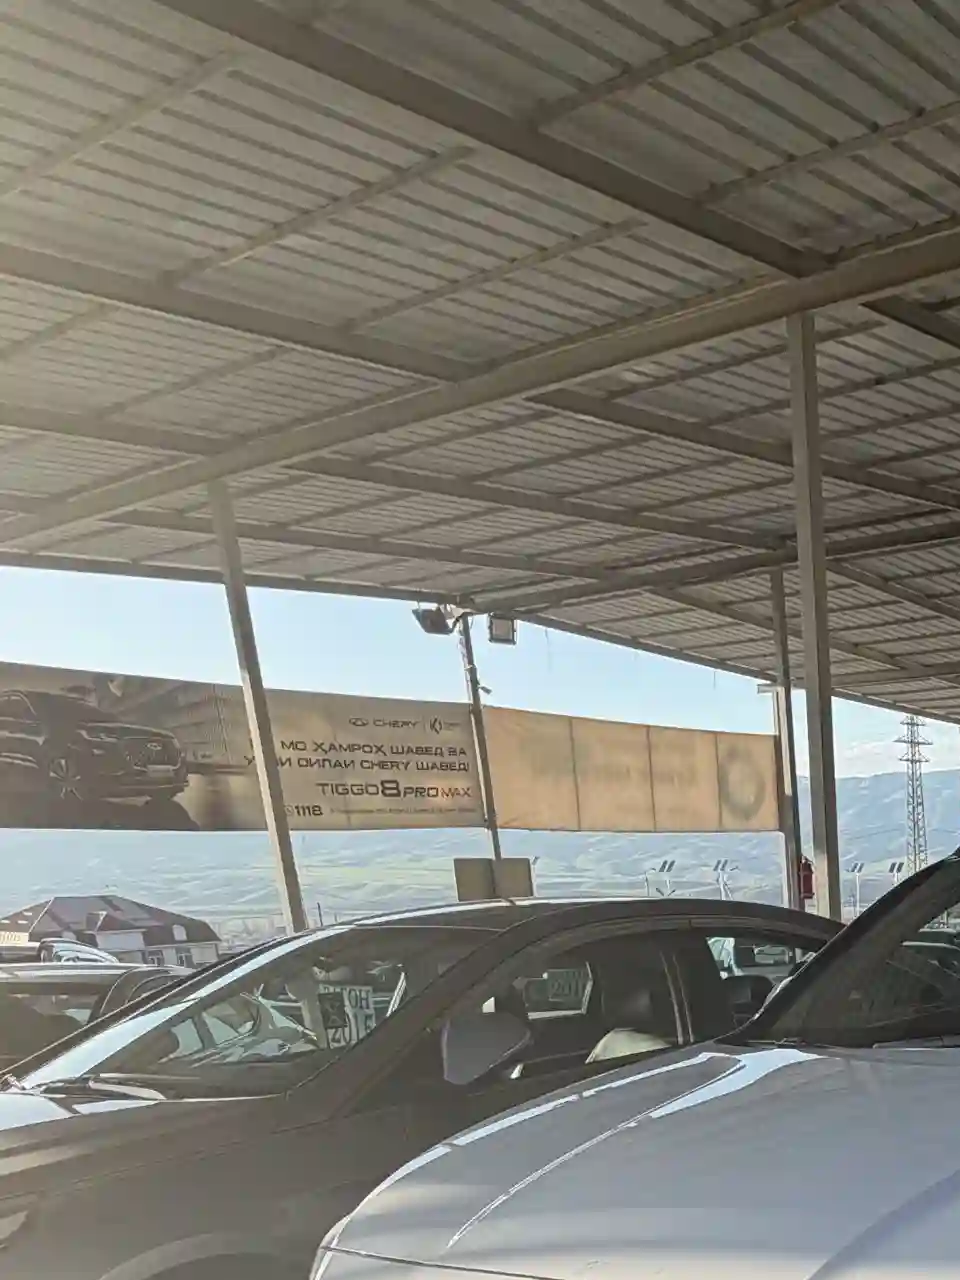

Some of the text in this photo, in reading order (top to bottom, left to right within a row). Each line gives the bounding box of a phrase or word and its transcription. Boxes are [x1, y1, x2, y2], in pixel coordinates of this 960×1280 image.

[373, 719, 420, 728] CHERY
[280, 740, 307, 751] МО
[390, 745, 444, 757] ШАВЕД
[360, 760, 411, 771] CHERY
[316, 783, 379, 796] TIGGO
[294, 804, 323, 816] 1118
